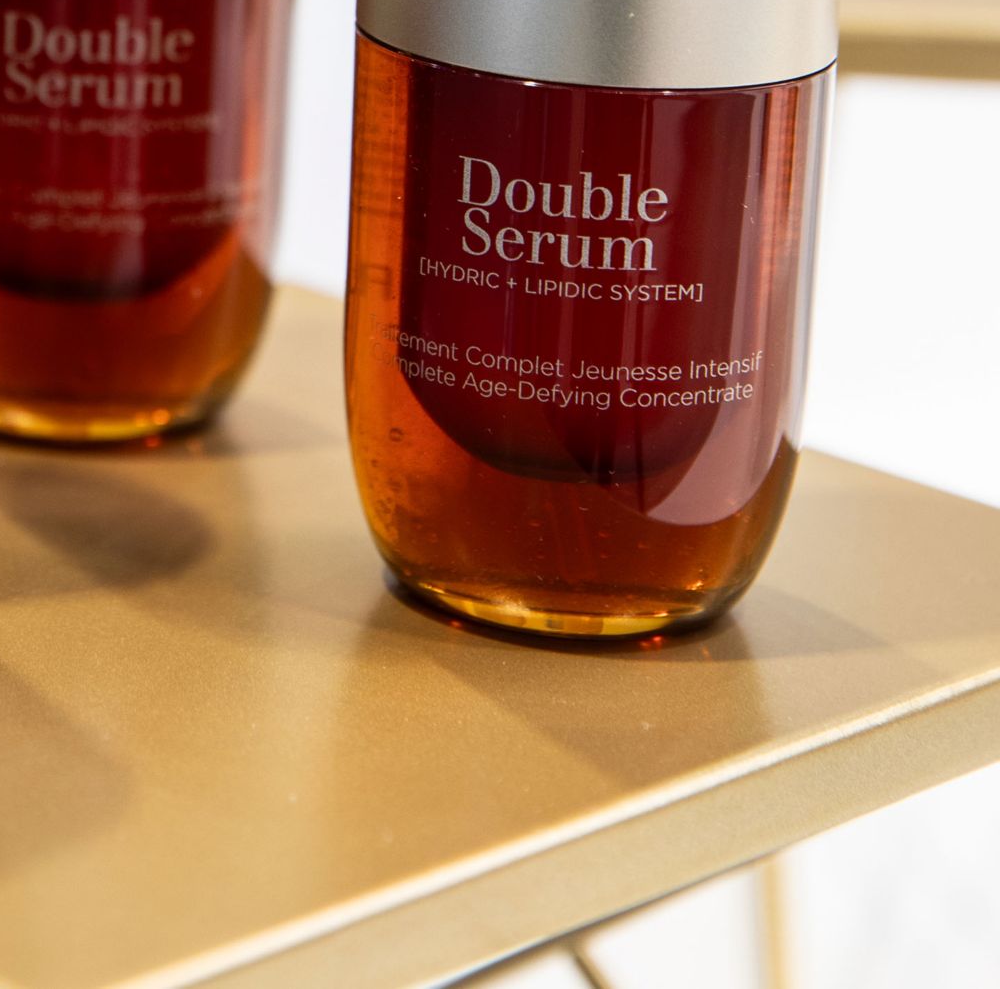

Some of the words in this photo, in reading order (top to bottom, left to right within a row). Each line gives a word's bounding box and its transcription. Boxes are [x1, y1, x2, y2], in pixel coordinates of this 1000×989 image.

[3, 10, 196, 64] Double
[3, 56, 183, 109] Serum
[457, 155, 669, 223] Double
[461, 207, 658, 271] Serum
[419, 257, 500, 289] [HYDRIC
[506, 277, 518, 290] +
[525, 277, 602, 300] LIPIDIC
[610, 282, 704, 302] SYSTEM]
[371, 313, 460, 362] aitement
[465, 345, 564, 378] Complet
[571, 360, 682, 382] Jeunesse
[689, 349, 763, 379] Intensif
[461, 372, 612, 411] Age-Defying
[619, 381, 754, 408] Concentrate
